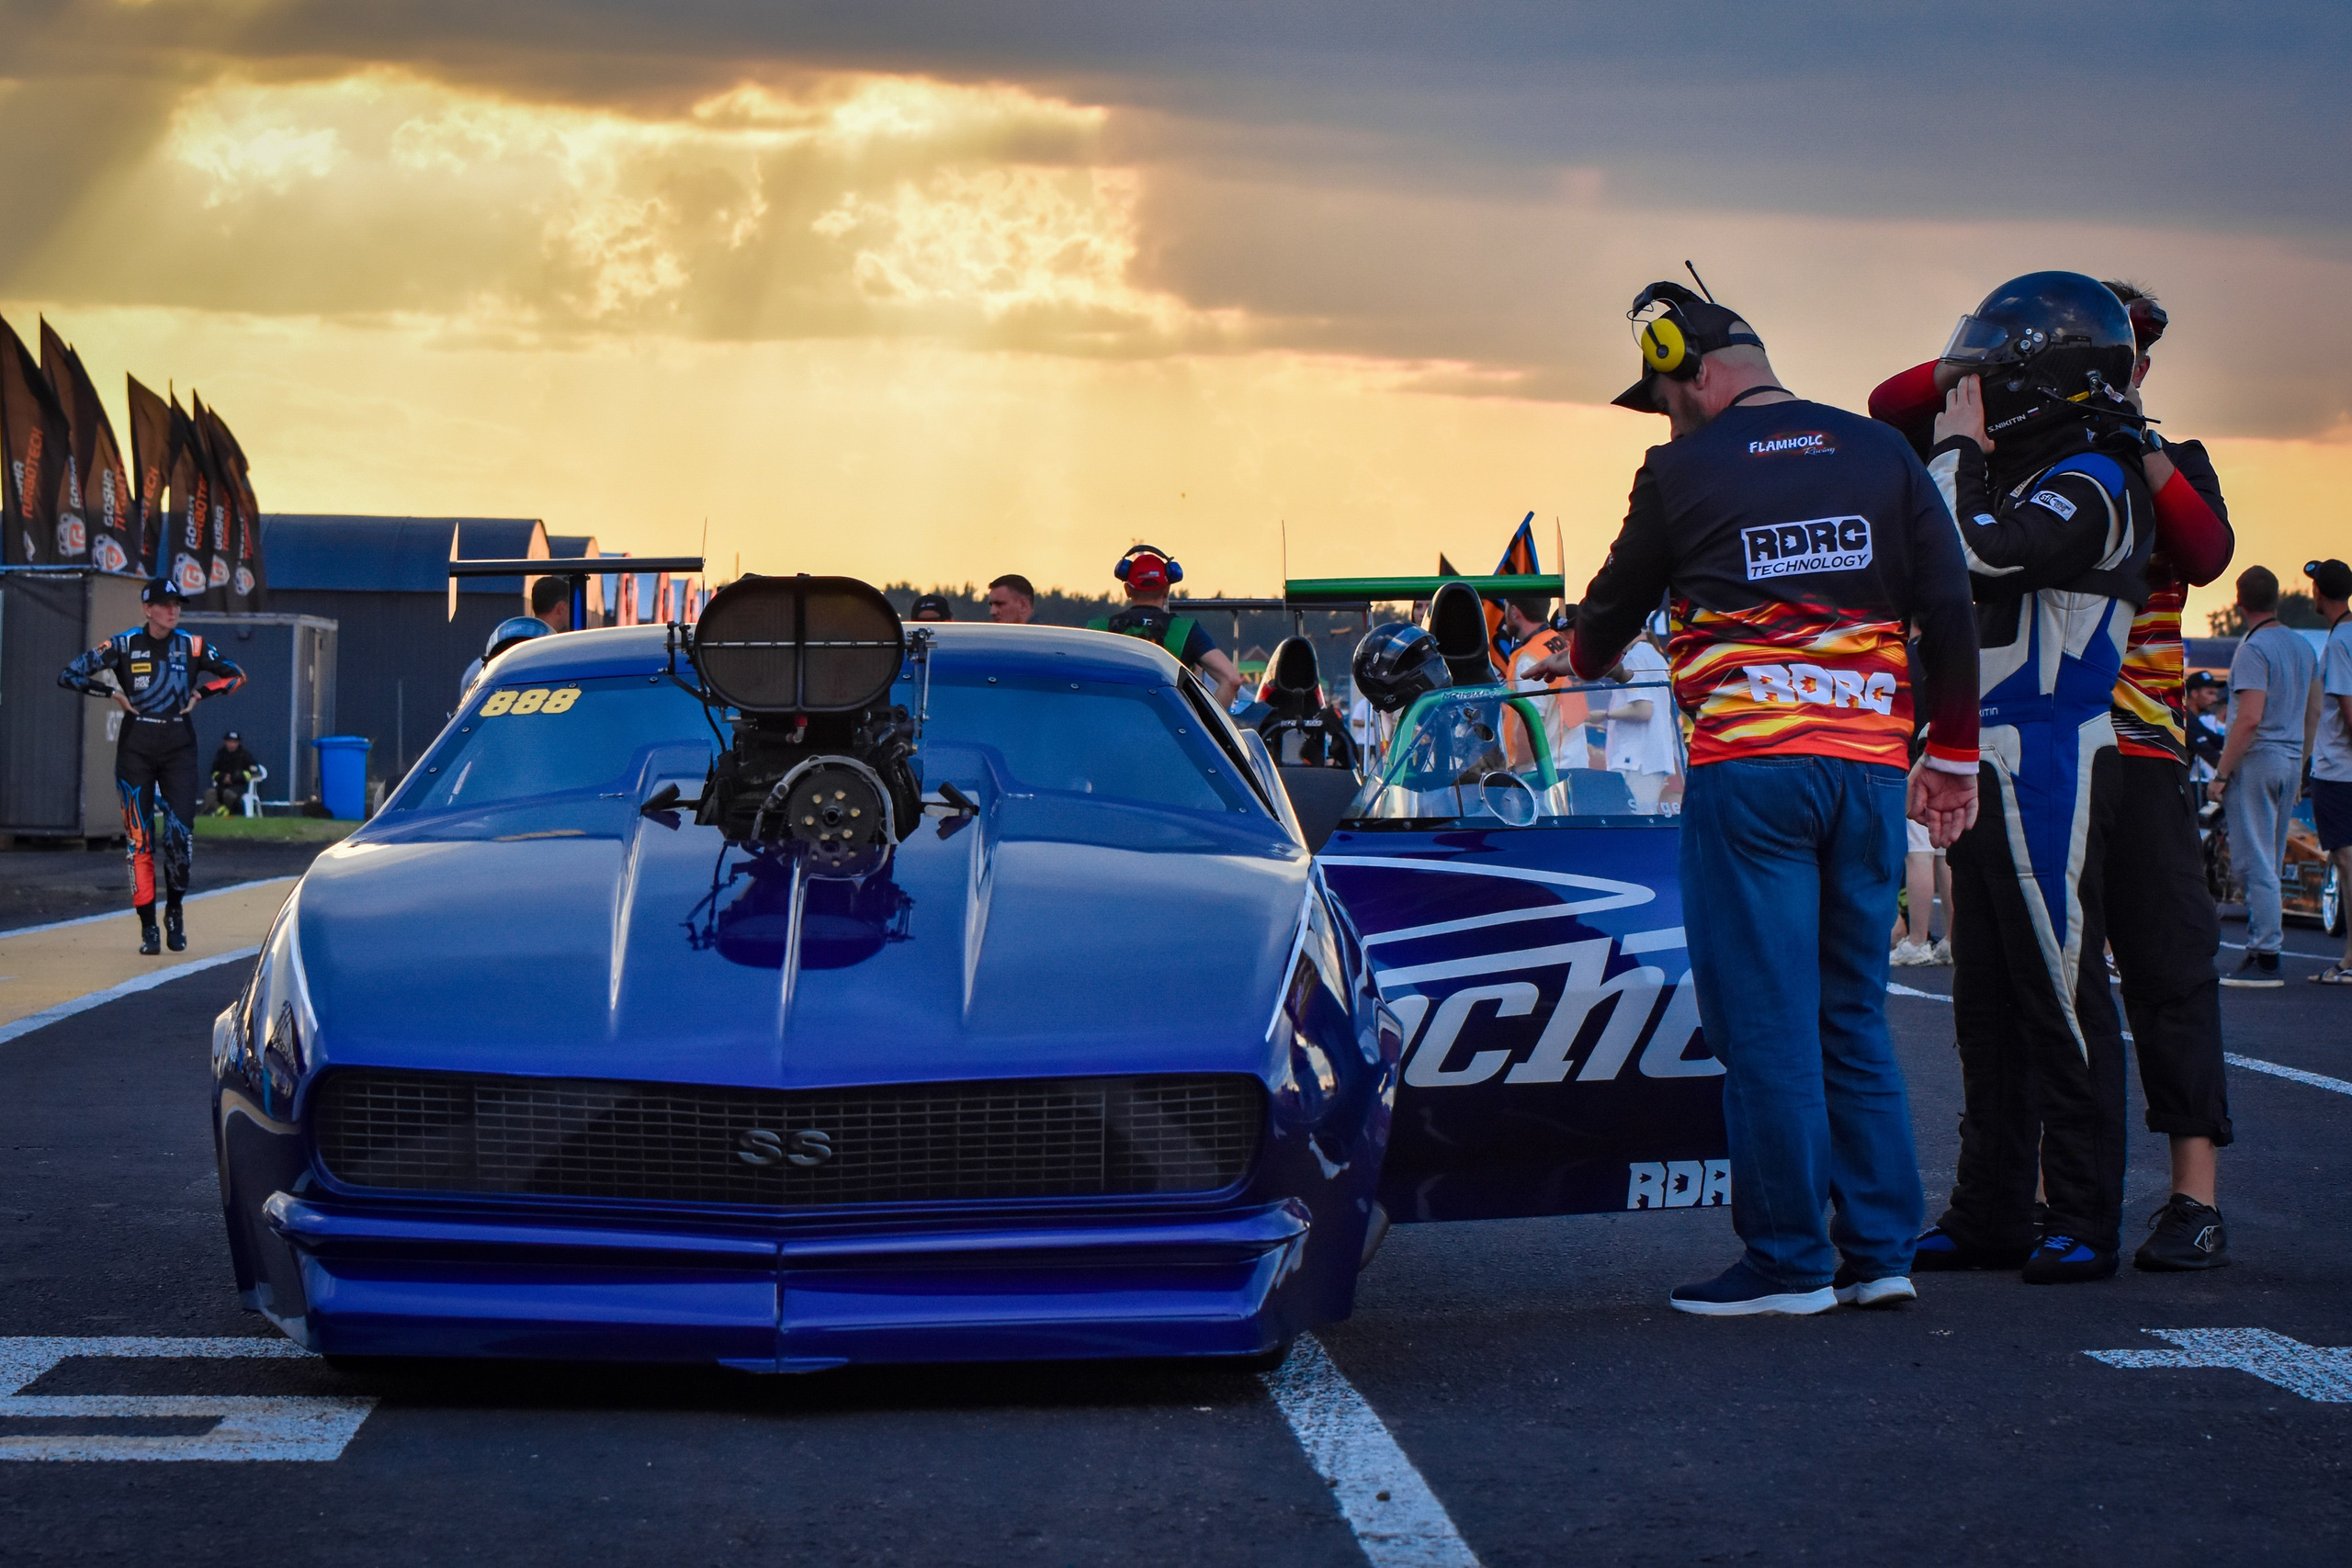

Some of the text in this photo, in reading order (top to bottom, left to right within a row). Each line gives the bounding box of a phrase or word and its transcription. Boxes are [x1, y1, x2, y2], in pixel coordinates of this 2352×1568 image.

[1987, 413, 2026, 433] S.NIKITIN
[1749, 434, 1823, 454] FLAMHOLC
[103, 468, 115, 527] GOSHA
[1746, 519, 1868, 563] RDRC
[1750, 553, 1869, 578] TECHNOLOGY
[479, 688, 582, 717] 888
[1742, 663, 1896, 716] RDRC
[737, 1129, 832, 1167] SS
